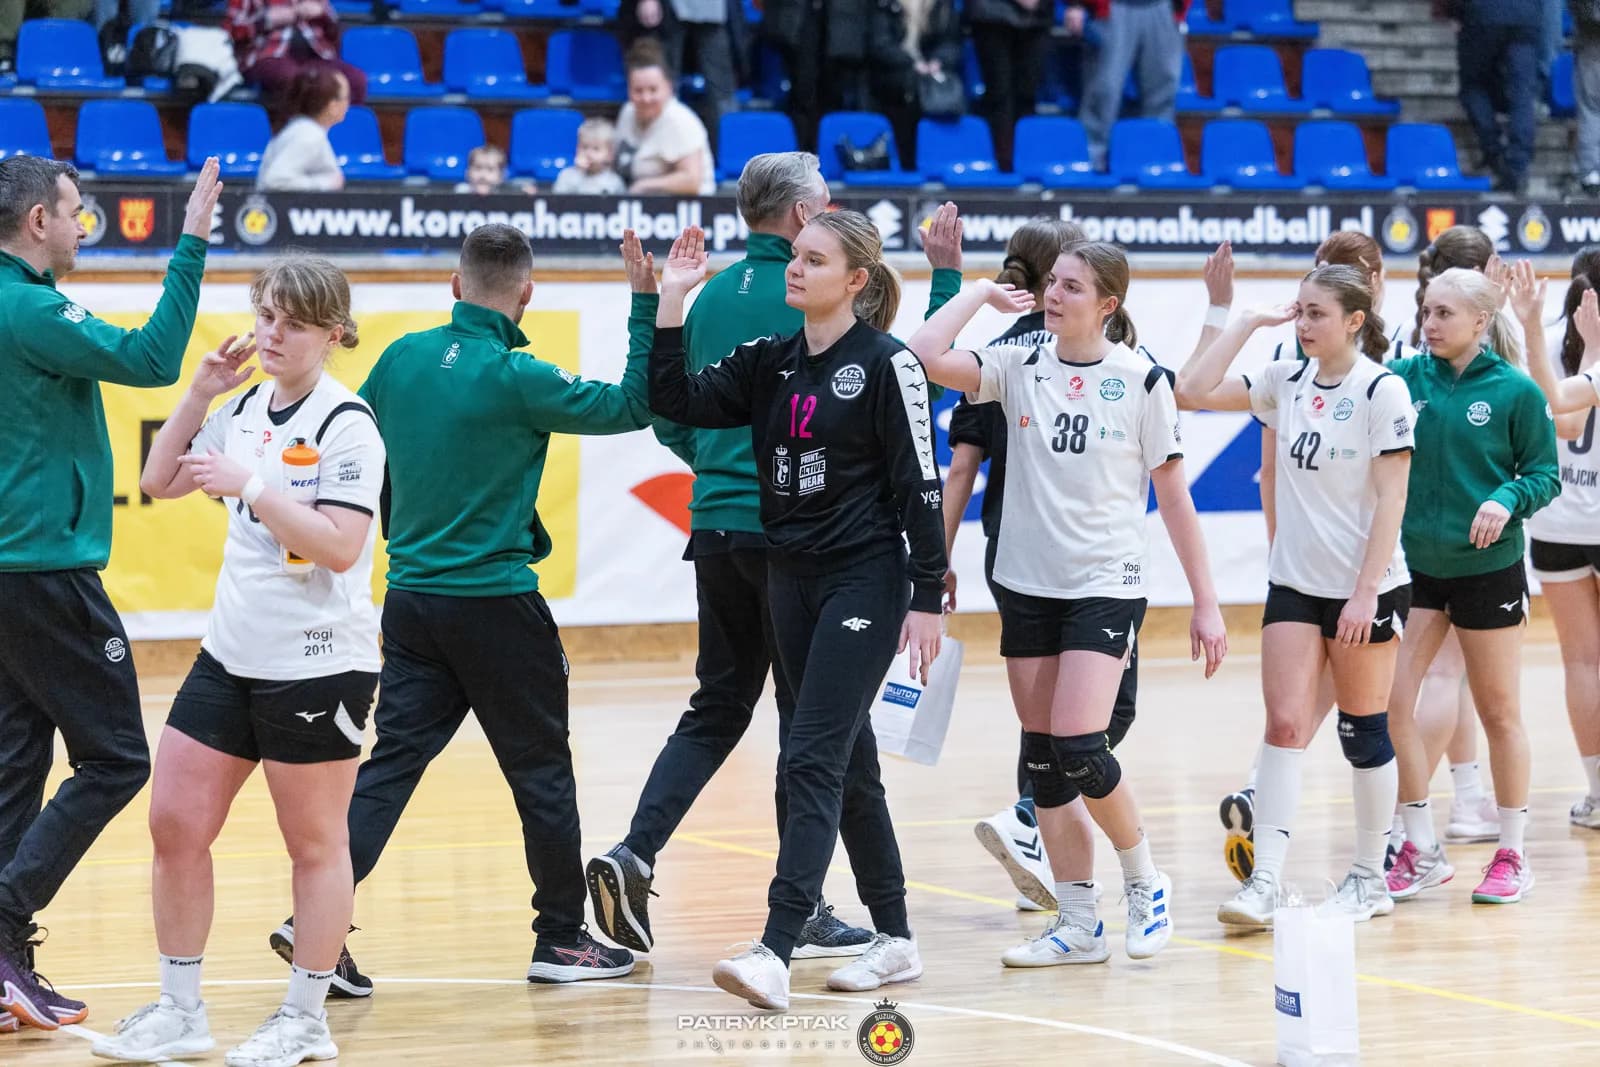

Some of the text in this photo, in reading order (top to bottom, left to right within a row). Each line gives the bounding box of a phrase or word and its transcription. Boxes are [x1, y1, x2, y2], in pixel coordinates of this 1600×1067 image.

[962, 204, 1373, 245] wworonahandballl
[842, 369, 860, 379] AZS
[837, 382, 862, 392] AWF
[789, 393, 817, 438] 12
[1052, 412, 1089, 454] 38
[1290, 431, 1321, 471] 42
[800, 452, 819, 465] PRINT
[799, 460, 825, 477] ACTIVE
[799, 473, 825, 490] WEAR
[1122, 560, 1141, 574] Yogi
[1122, 575, 1141, 585] 2011
[841, 616, 872, 632] 4F
[303, 628, 333, 642] Yogi
[303, 643, 333, 657] 2011
[1026, 761, 1051, 770] SELECT
